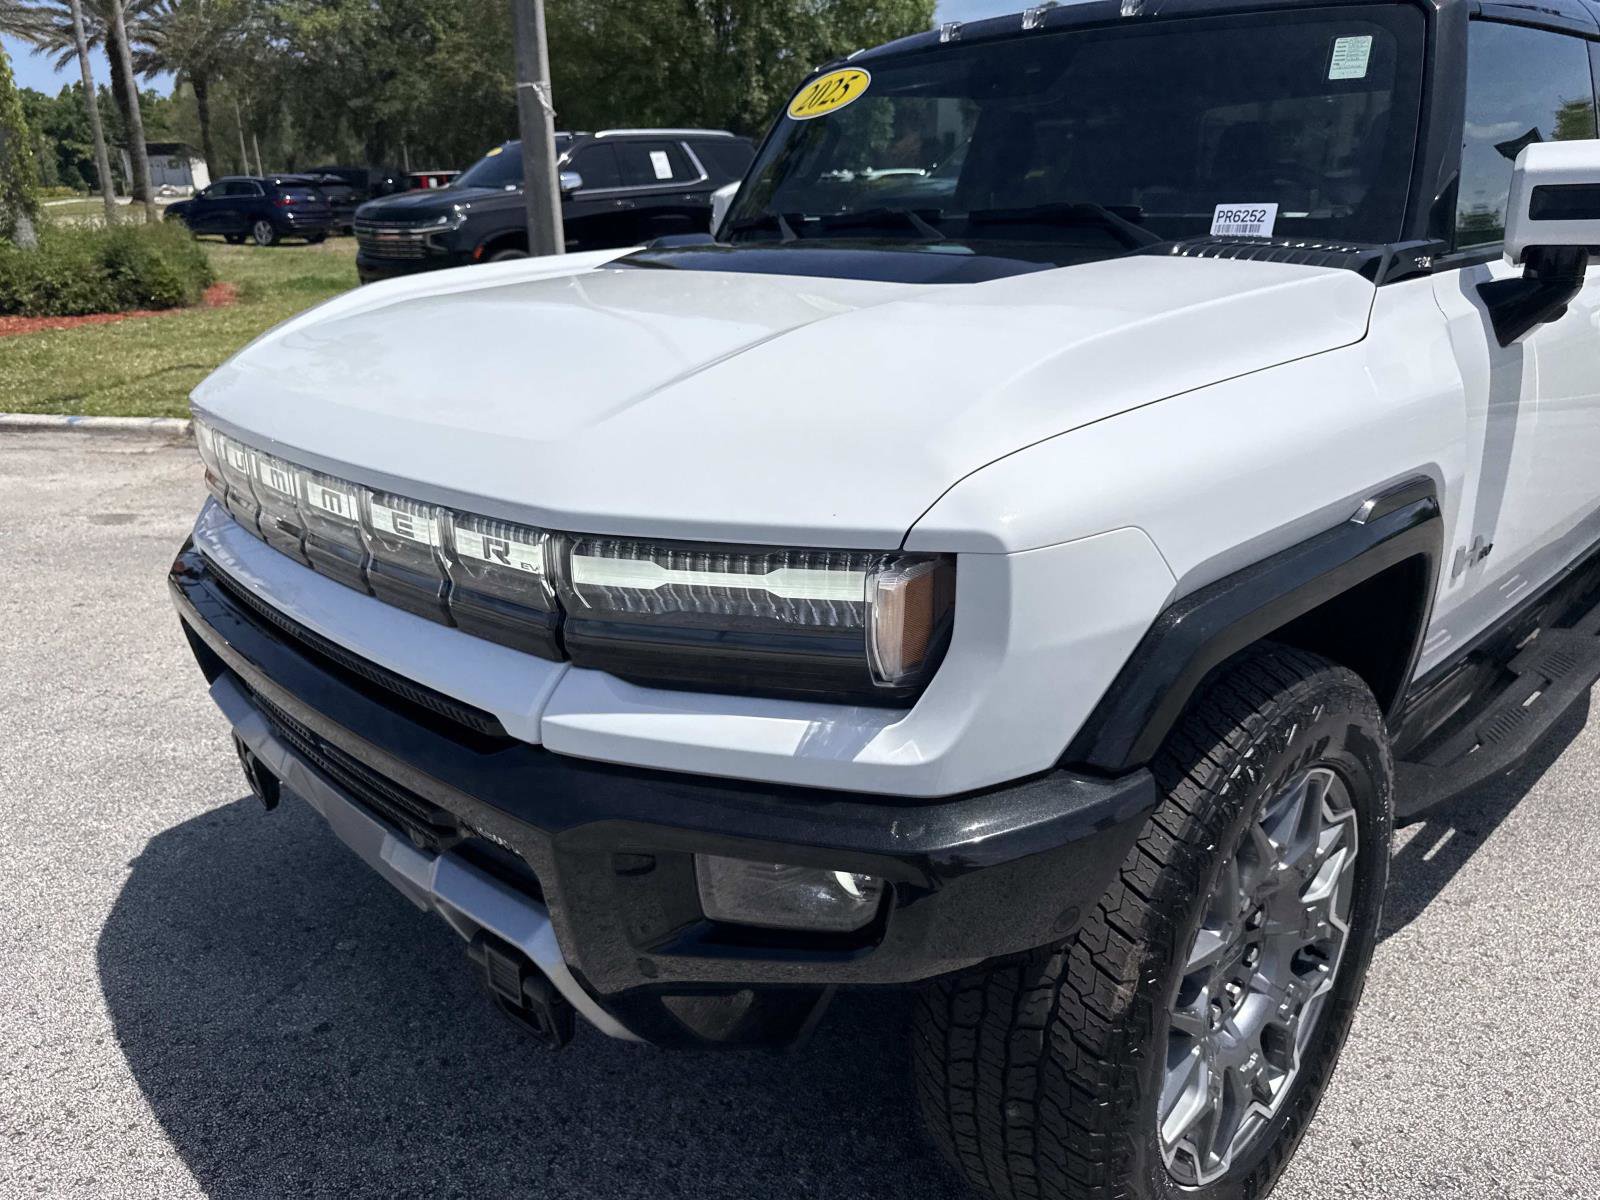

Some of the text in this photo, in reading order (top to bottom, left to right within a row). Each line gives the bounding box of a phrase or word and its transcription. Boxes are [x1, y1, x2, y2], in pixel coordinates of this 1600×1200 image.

[795, 75, 860, 112] 2025
[1216, 210, 1267, 223] PR6252
[234, 451, 540, 572] UMMER EV
